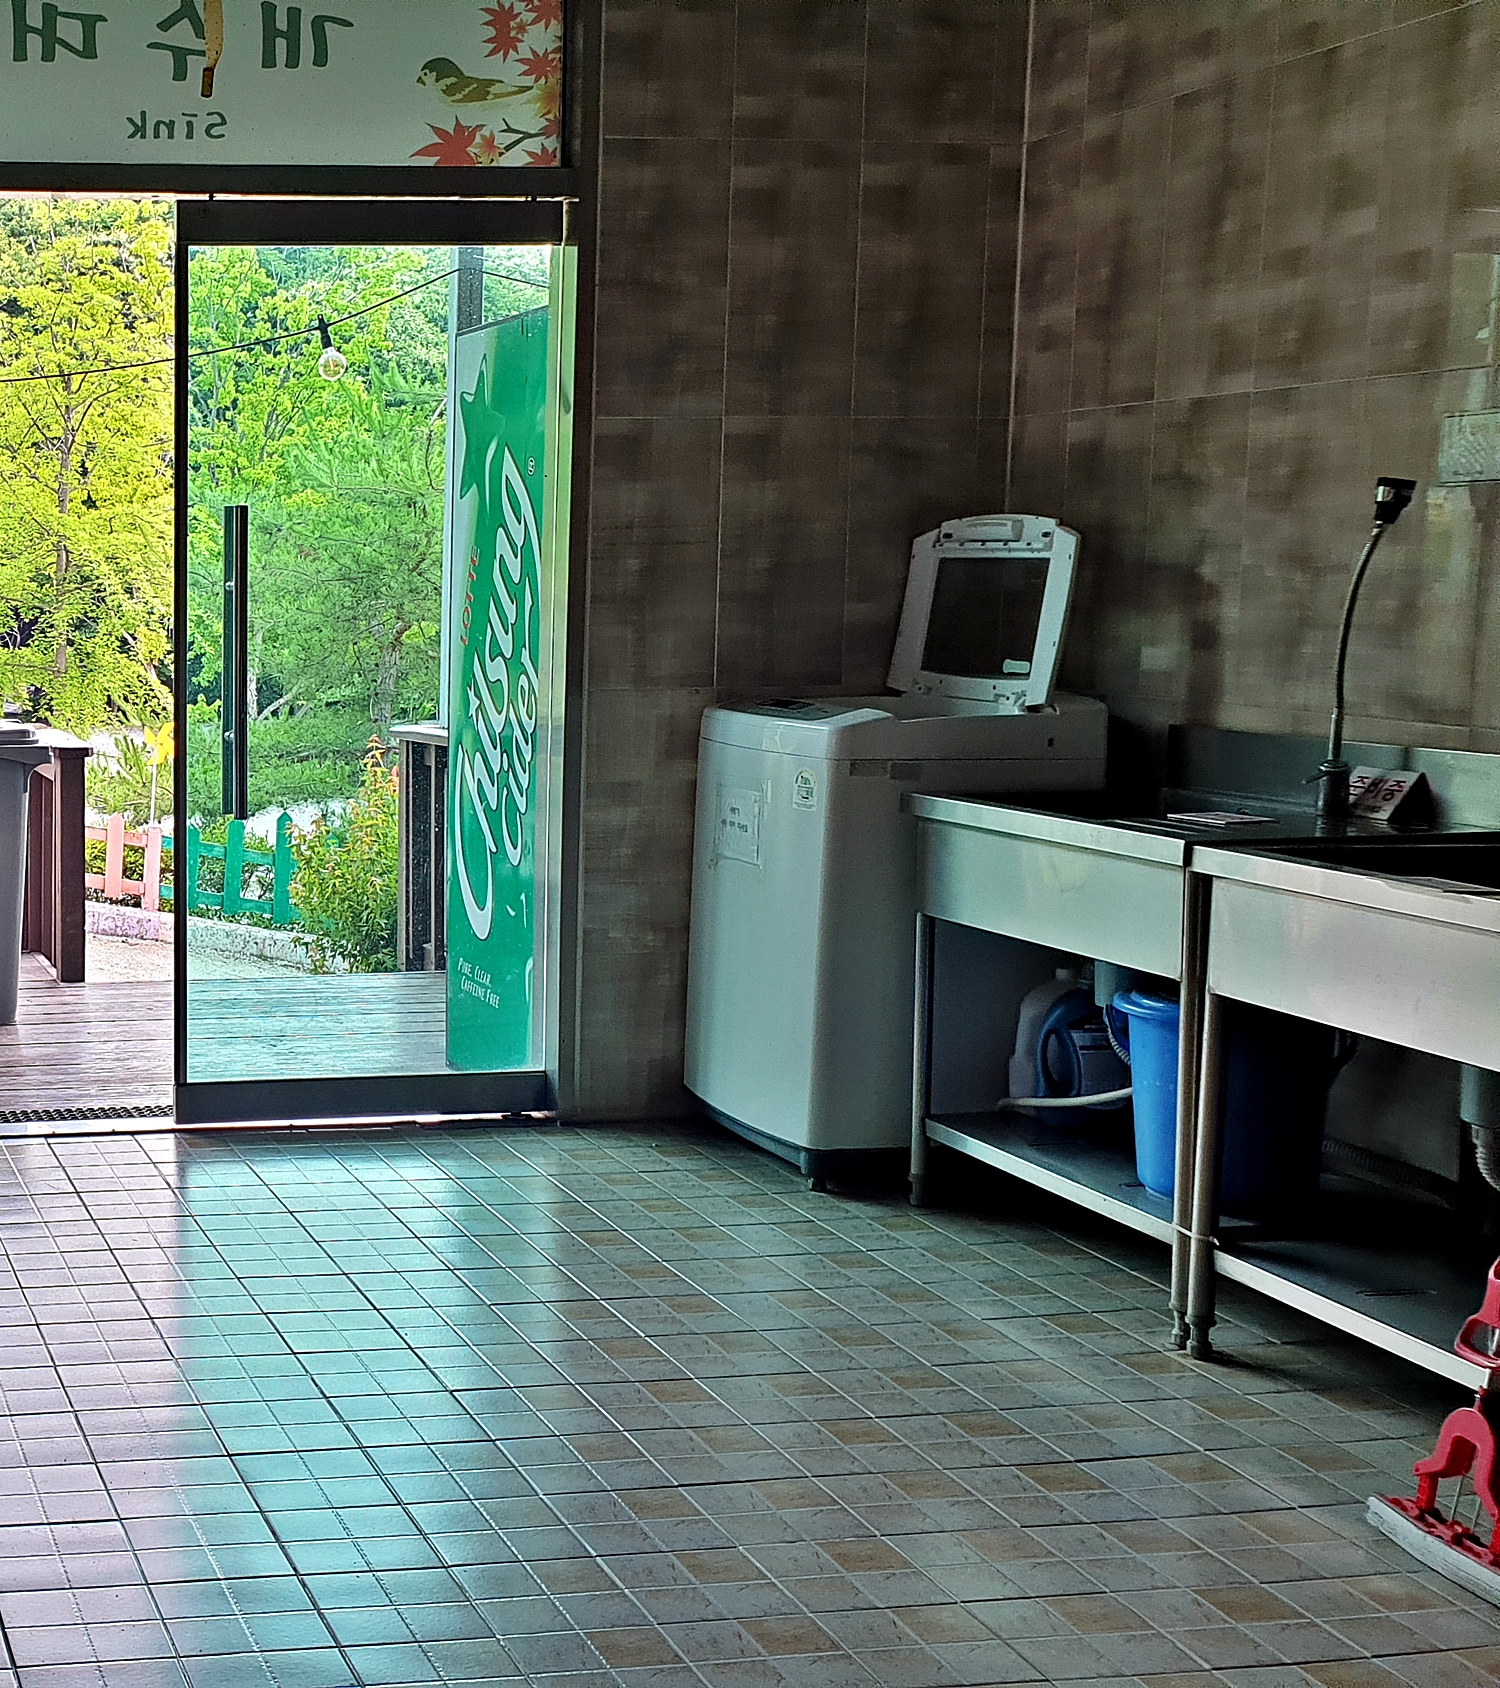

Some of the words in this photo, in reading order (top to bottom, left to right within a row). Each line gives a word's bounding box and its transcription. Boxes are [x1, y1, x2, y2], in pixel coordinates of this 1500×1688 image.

[460, 547, 479, 646] LOTTE
[453, 441, 542, 940] Chilsung
[461, 975, 485, 1001] CAFFEINE
[486, 988, 500, 1009] FREE
